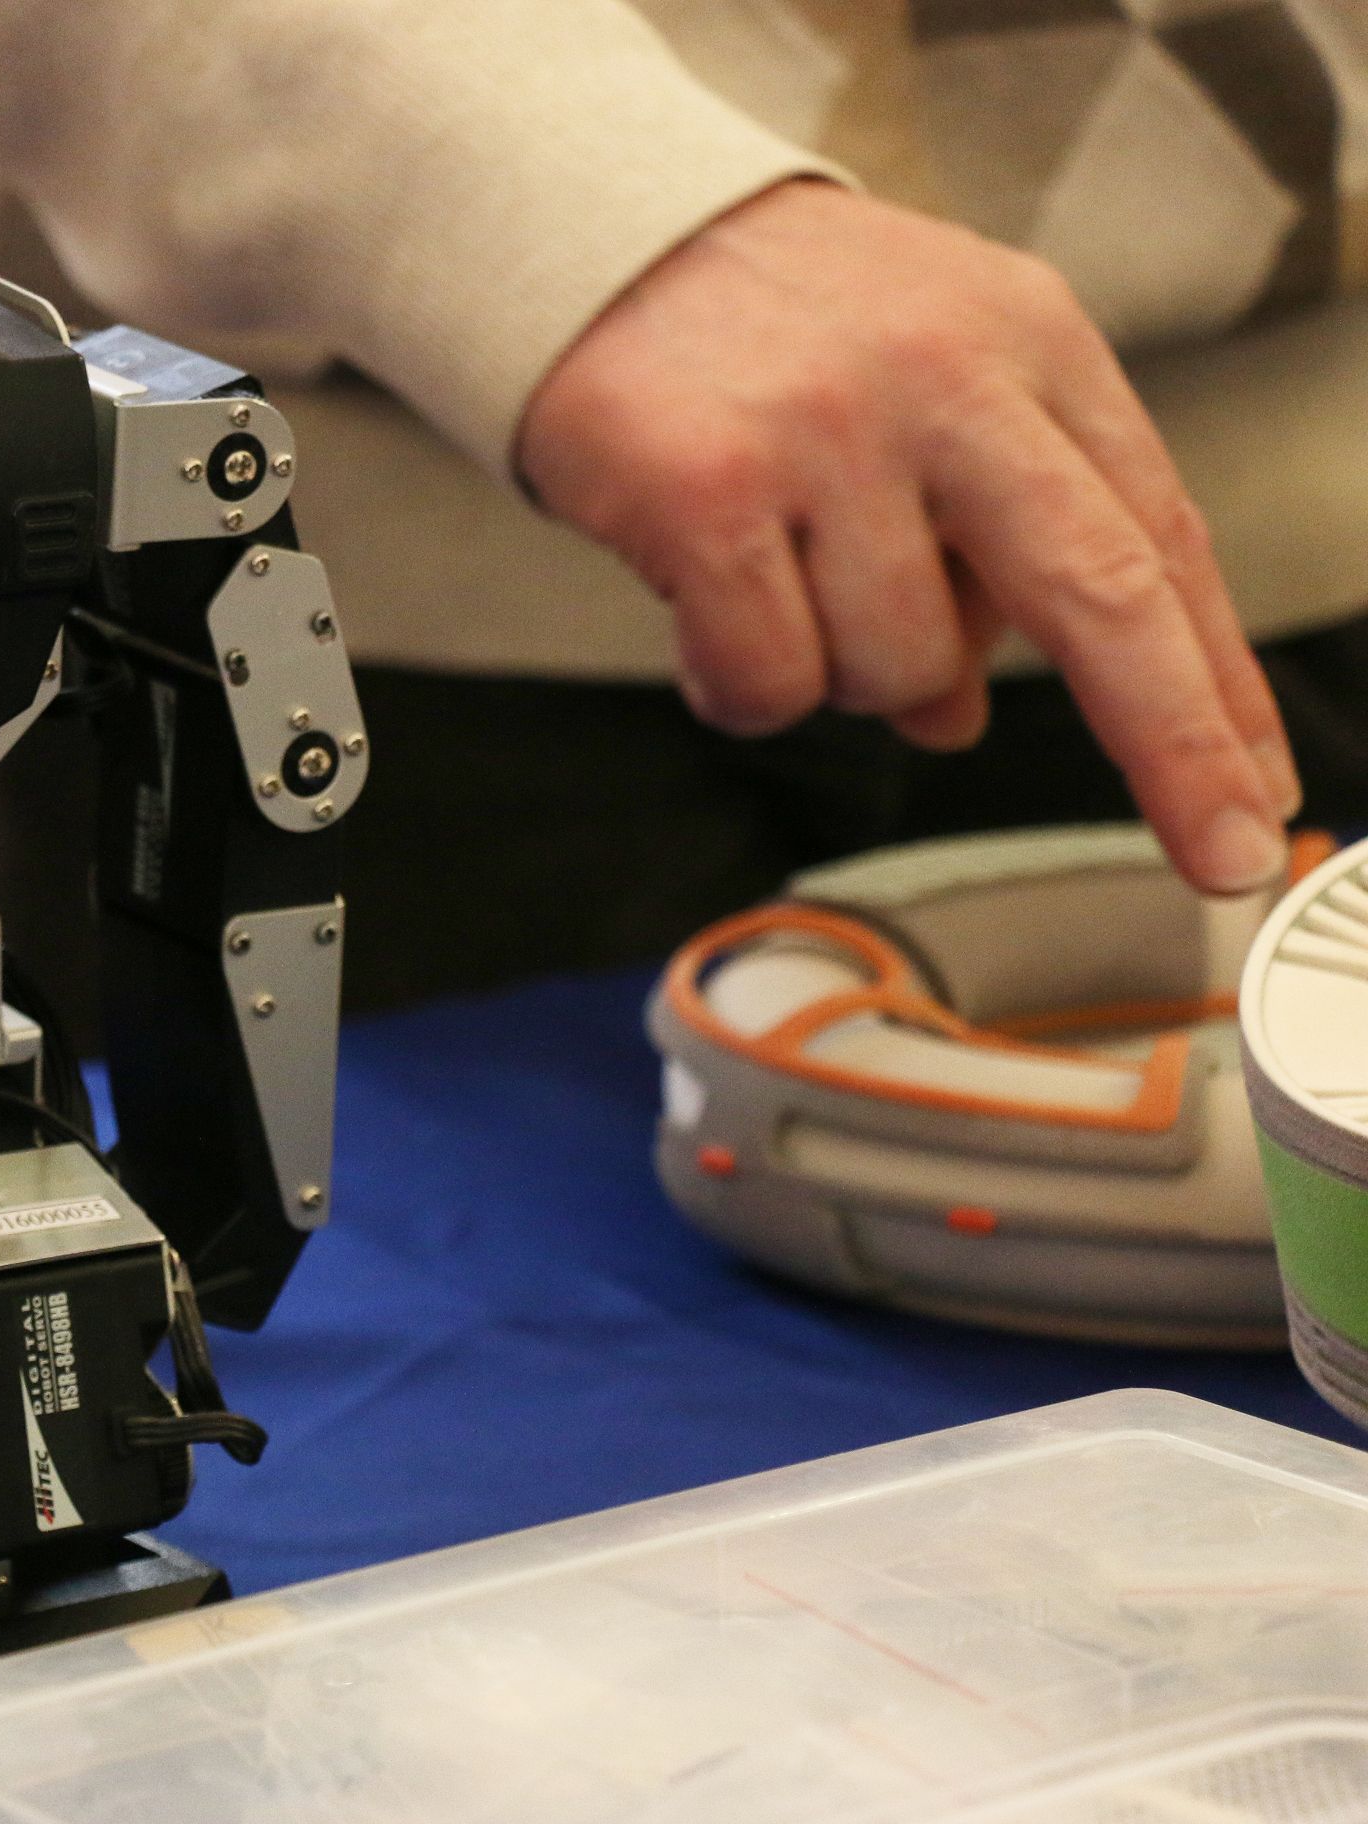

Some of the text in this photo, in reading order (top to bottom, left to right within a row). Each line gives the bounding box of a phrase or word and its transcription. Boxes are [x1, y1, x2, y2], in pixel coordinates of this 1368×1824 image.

[21, 1298, 43, 1416] DIGITAL
[32, 1295, 55, 1415] ROBOT SERVO
[48, 1291, 81, 1411] HSR-8498HB
